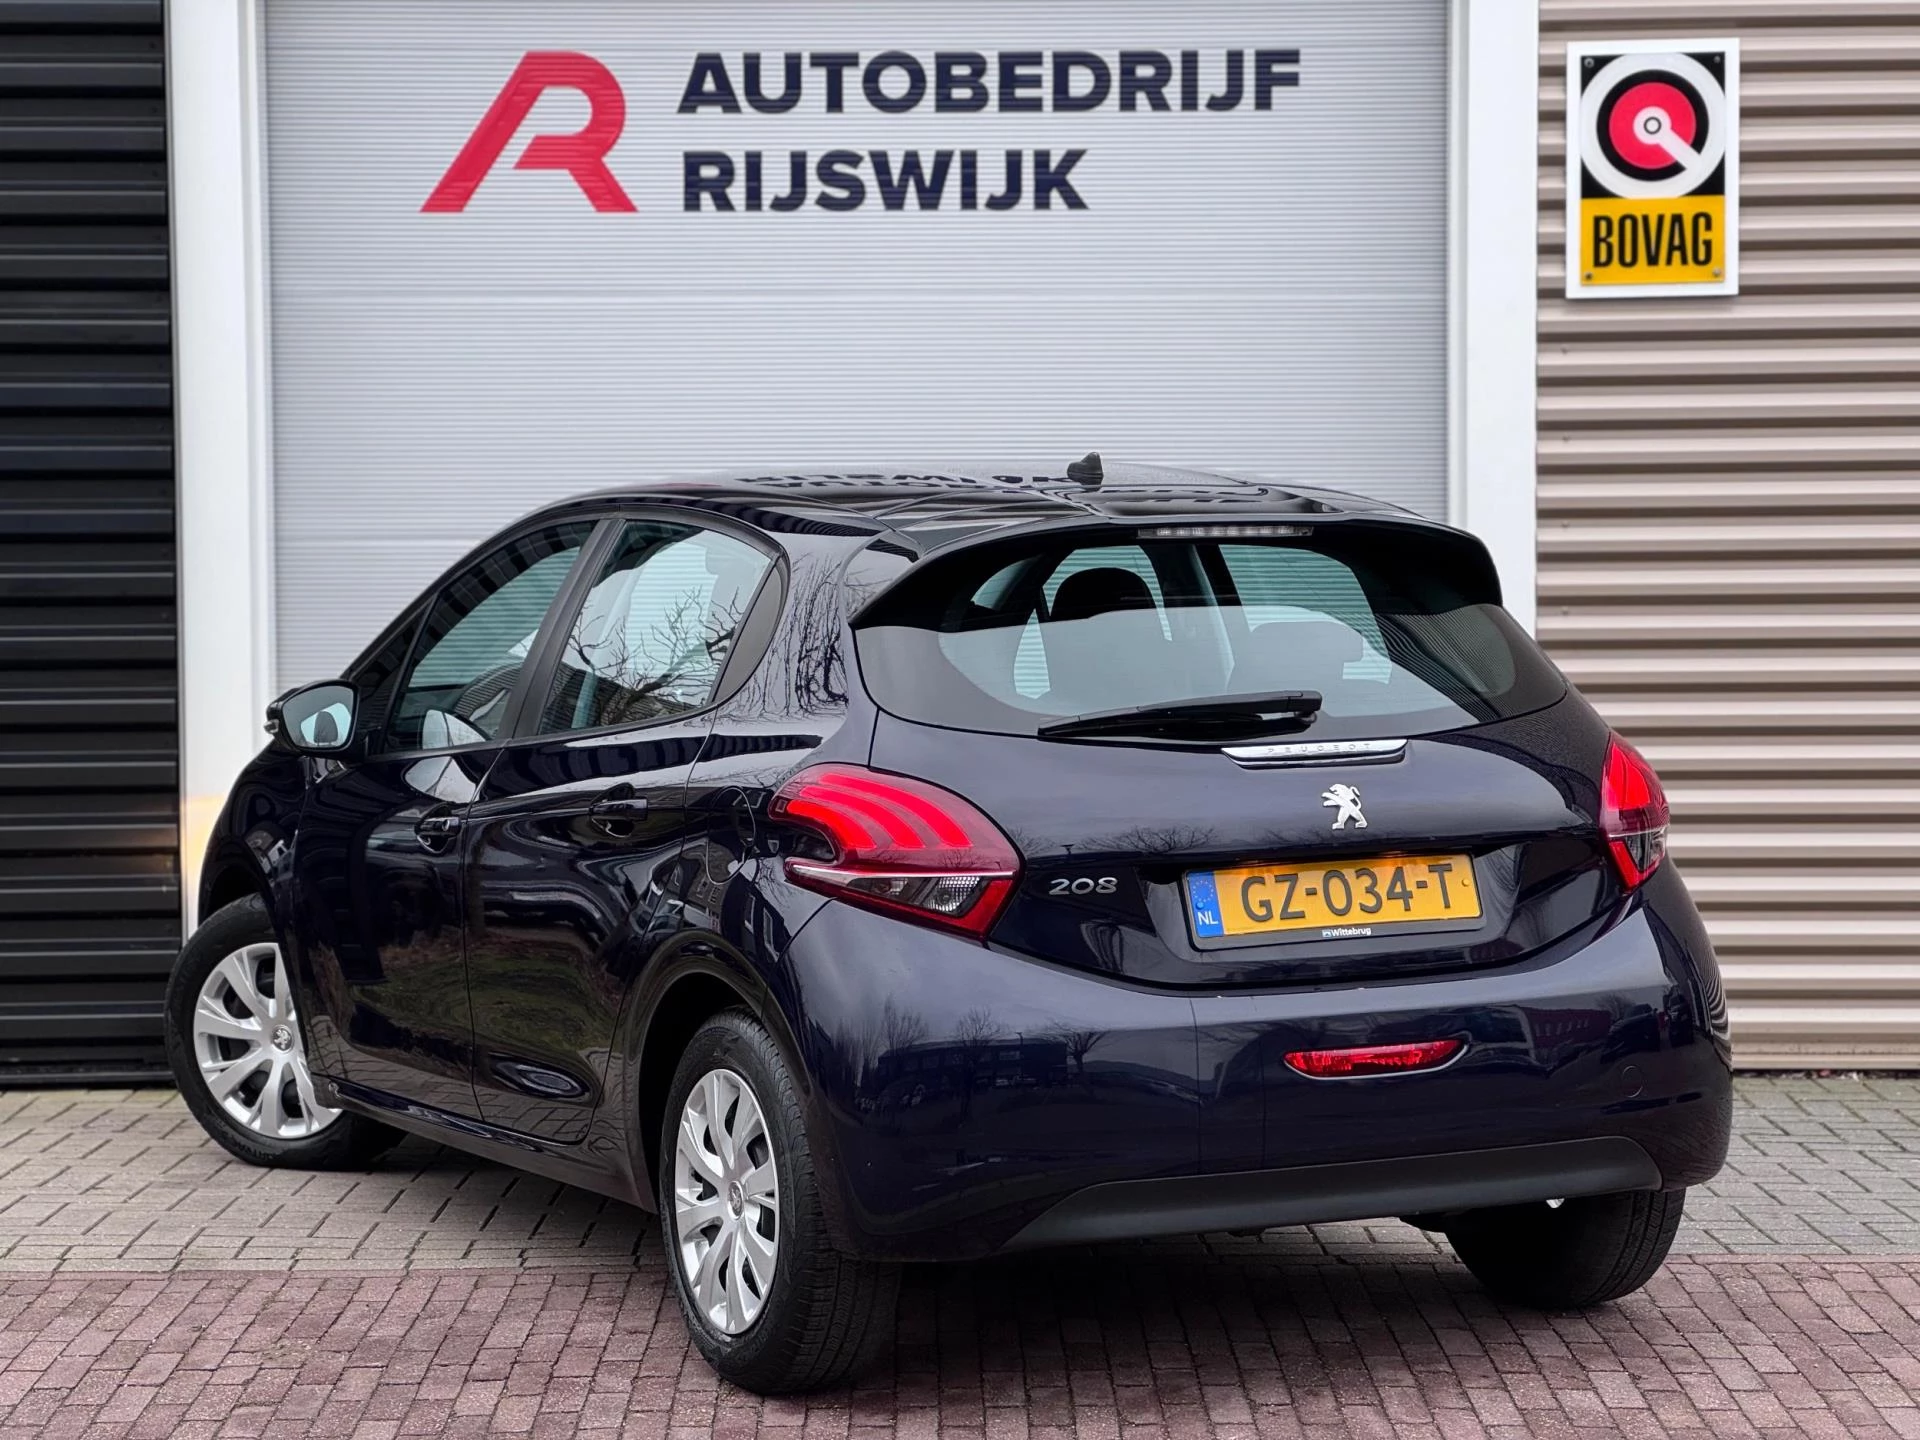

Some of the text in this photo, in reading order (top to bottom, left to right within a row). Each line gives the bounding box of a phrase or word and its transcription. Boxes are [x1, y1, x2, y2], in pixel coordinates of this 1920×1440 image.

[677, 50, 1301, 114] AUTOBEDRIJF
[683, 149, 1088, 212] RIJSWIJK
[1593, 212, 1712, 267] BOVAG
[1049, 877, 1118, 895] 208
[1240, 863, 1453, 922] GZ-034-T
[1198, 910, 1219, 926] NL
